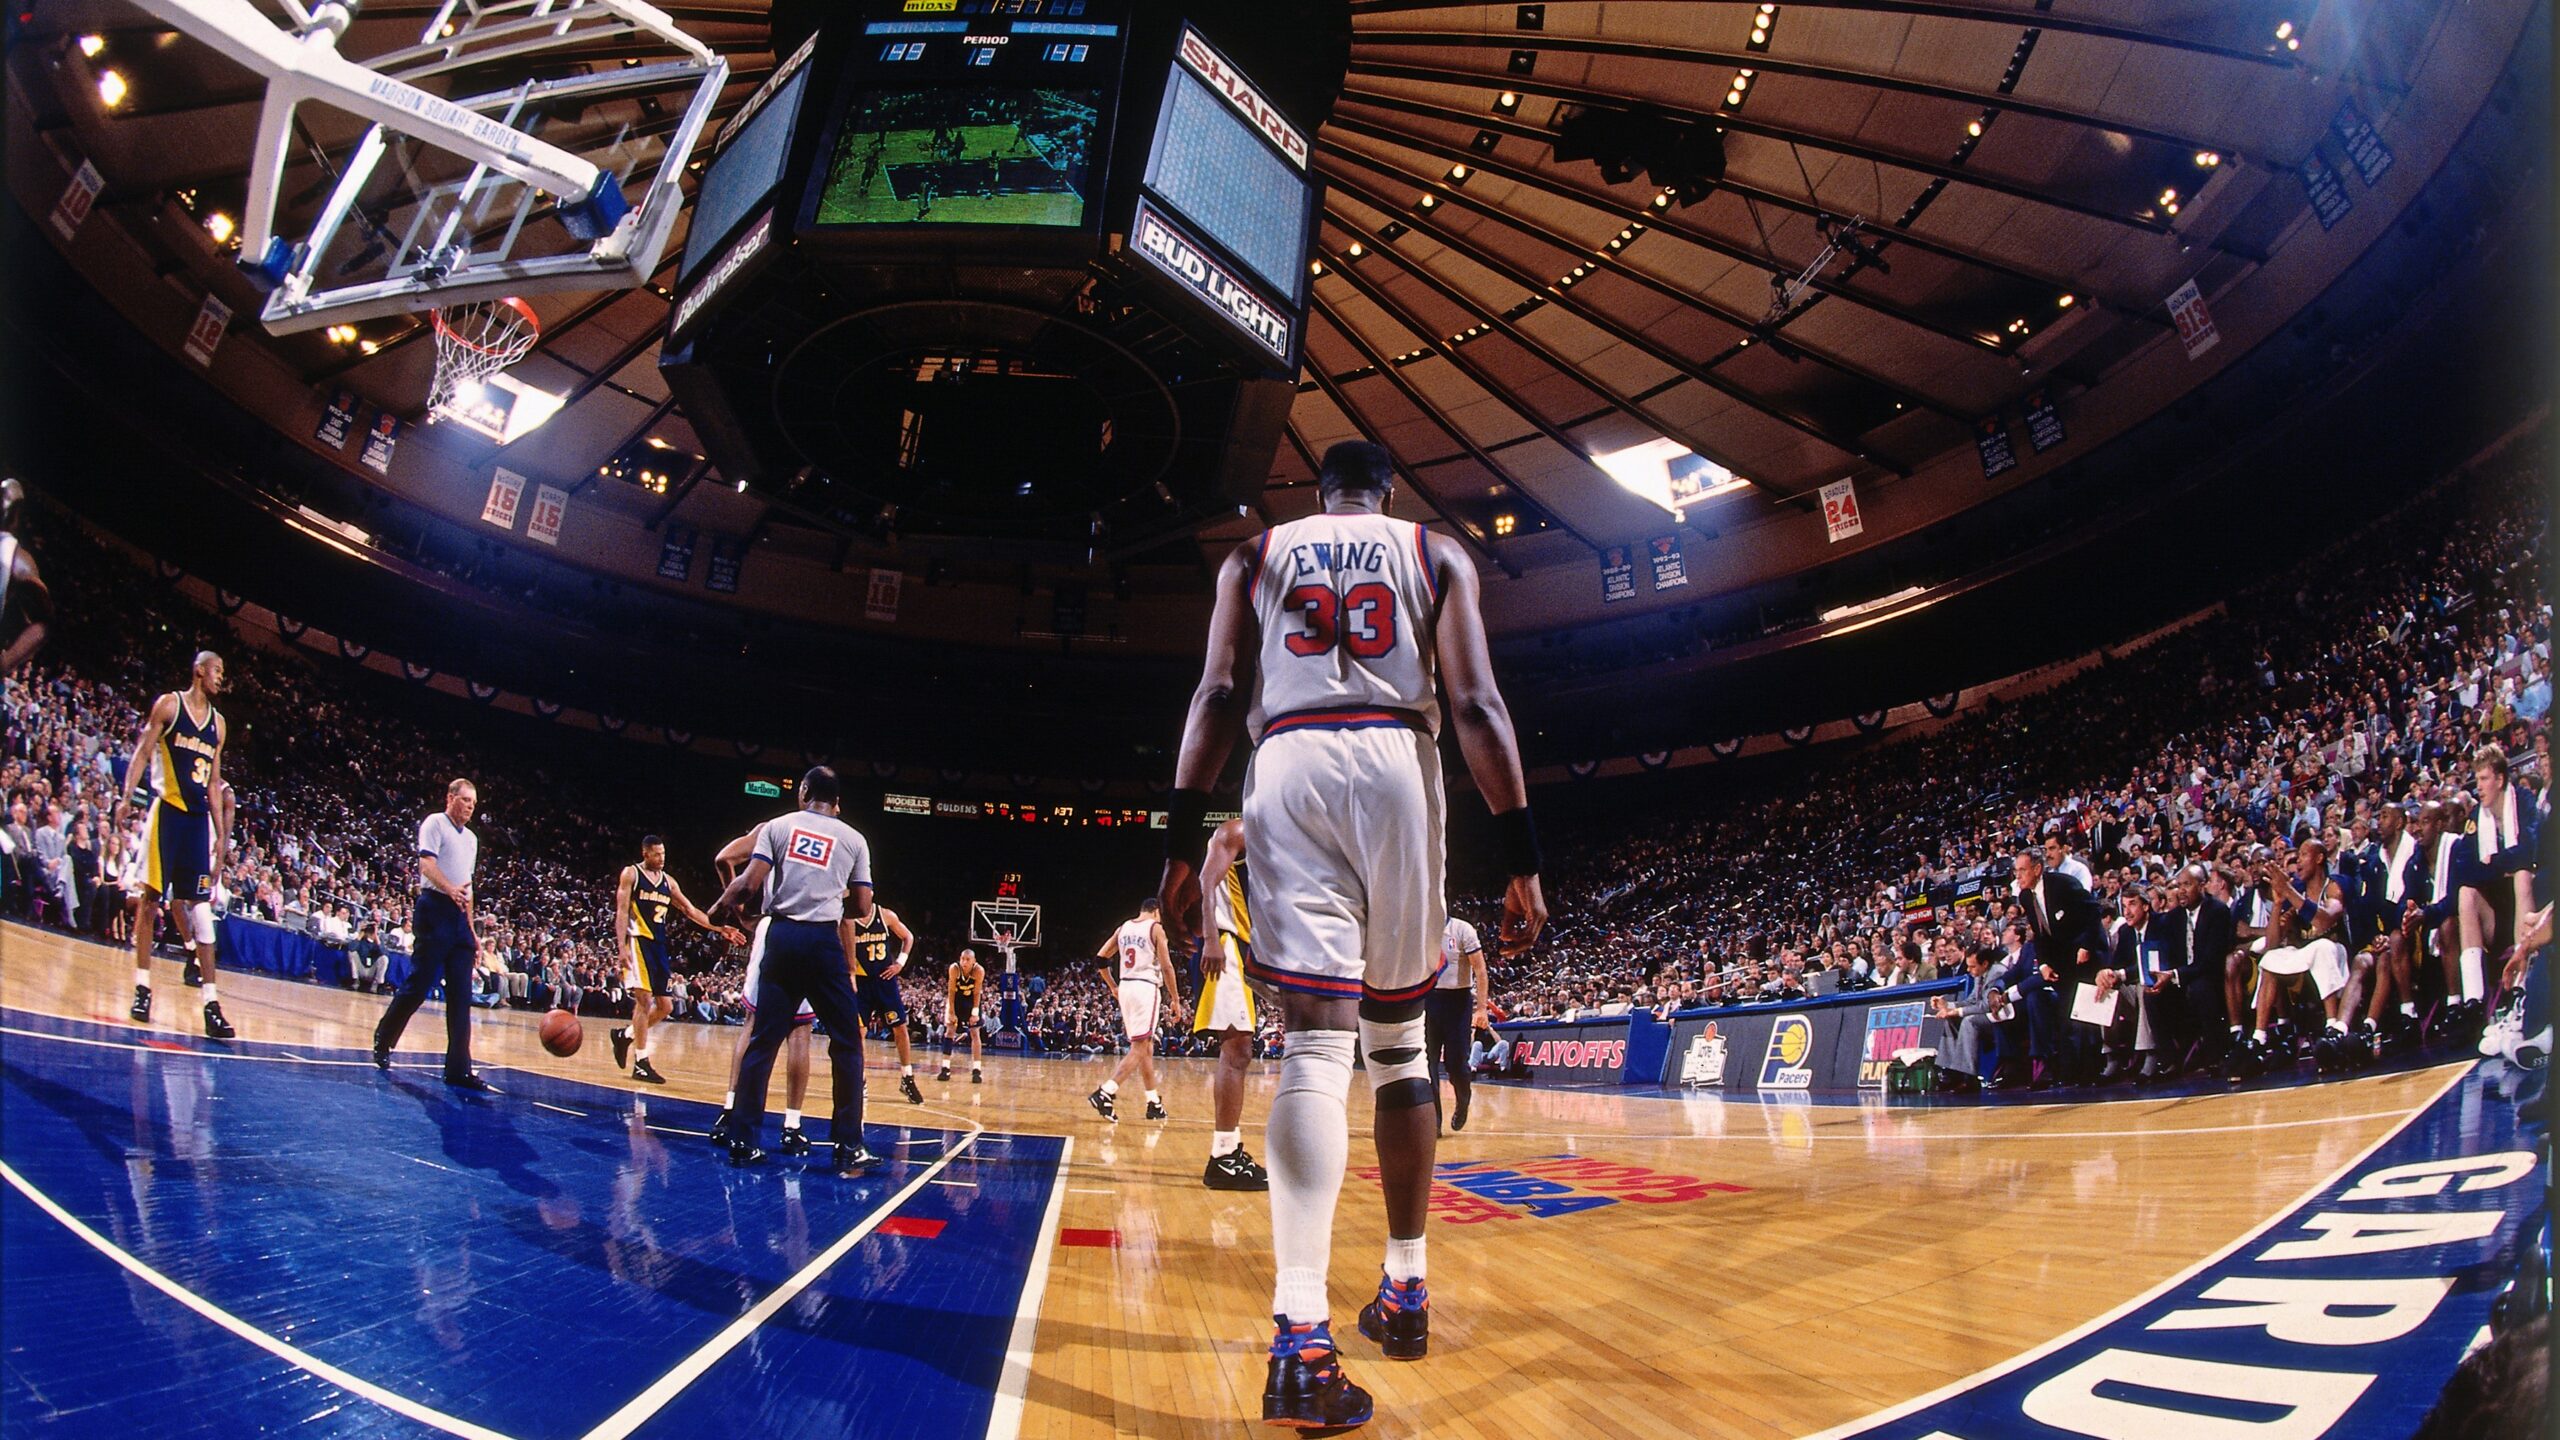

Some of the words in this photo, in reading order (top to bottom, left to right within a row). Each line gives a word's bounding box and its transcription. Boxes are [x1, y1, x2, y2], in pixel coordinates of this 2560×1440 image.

[963, 36, 1009, 45] PERIOD
[1182, 36, 1305, 158] SHARP
[369, 78, 424, 110] MADISON
[473, 119, 521, 150] GARDEN
[674, 223, 769, 332] Budweiser
[1142, 228, 1206, 283] BUD
[1207, 270, 1286, 350] LIGHT
[1825, 494, 1858, 526] 24
[1291, 541, 1387, 577] EWING
[1656, 561, 1680, 573] ATLANTIC
[1655, 576, 1688, 590] CHAMPIONS
[1658, 570, 1681, 581] DIVISION
[1283, 581, 1398, 659] 33
[173, 732, 215, 760] Indian
[748, 783, 778, 796] Marlboro
[886, 796, 930, 808] MODELL'S
[936, 802, 978, 814] GULDEN'S
[1054, 806, 1074, 816] 1:37
[797, 837, 825, 858] 25
[1003, 873, 1021, 882] 1:37
[639, 889, 671, 905] Indiana
[998, 883, 1016, 896] 24
[855, 932, 887, 944] ndiana
[866, 943, 887, 961] 13
[1124, 948, 1136, 969] 3
[1873, 1008, 1920, 1027] TBS
[1872, 1026, 1919, 1061] NBA
[1513, 1039, 1627, 1069] PLAYOFFS
[1780, 1073, 1809, 1084] Pacers
[1861, 1061, 1891, 1081] PLAY
[1433, 1170, 1621, 1218] NBA
[1916, 1151, 2538, 1440] GARD
